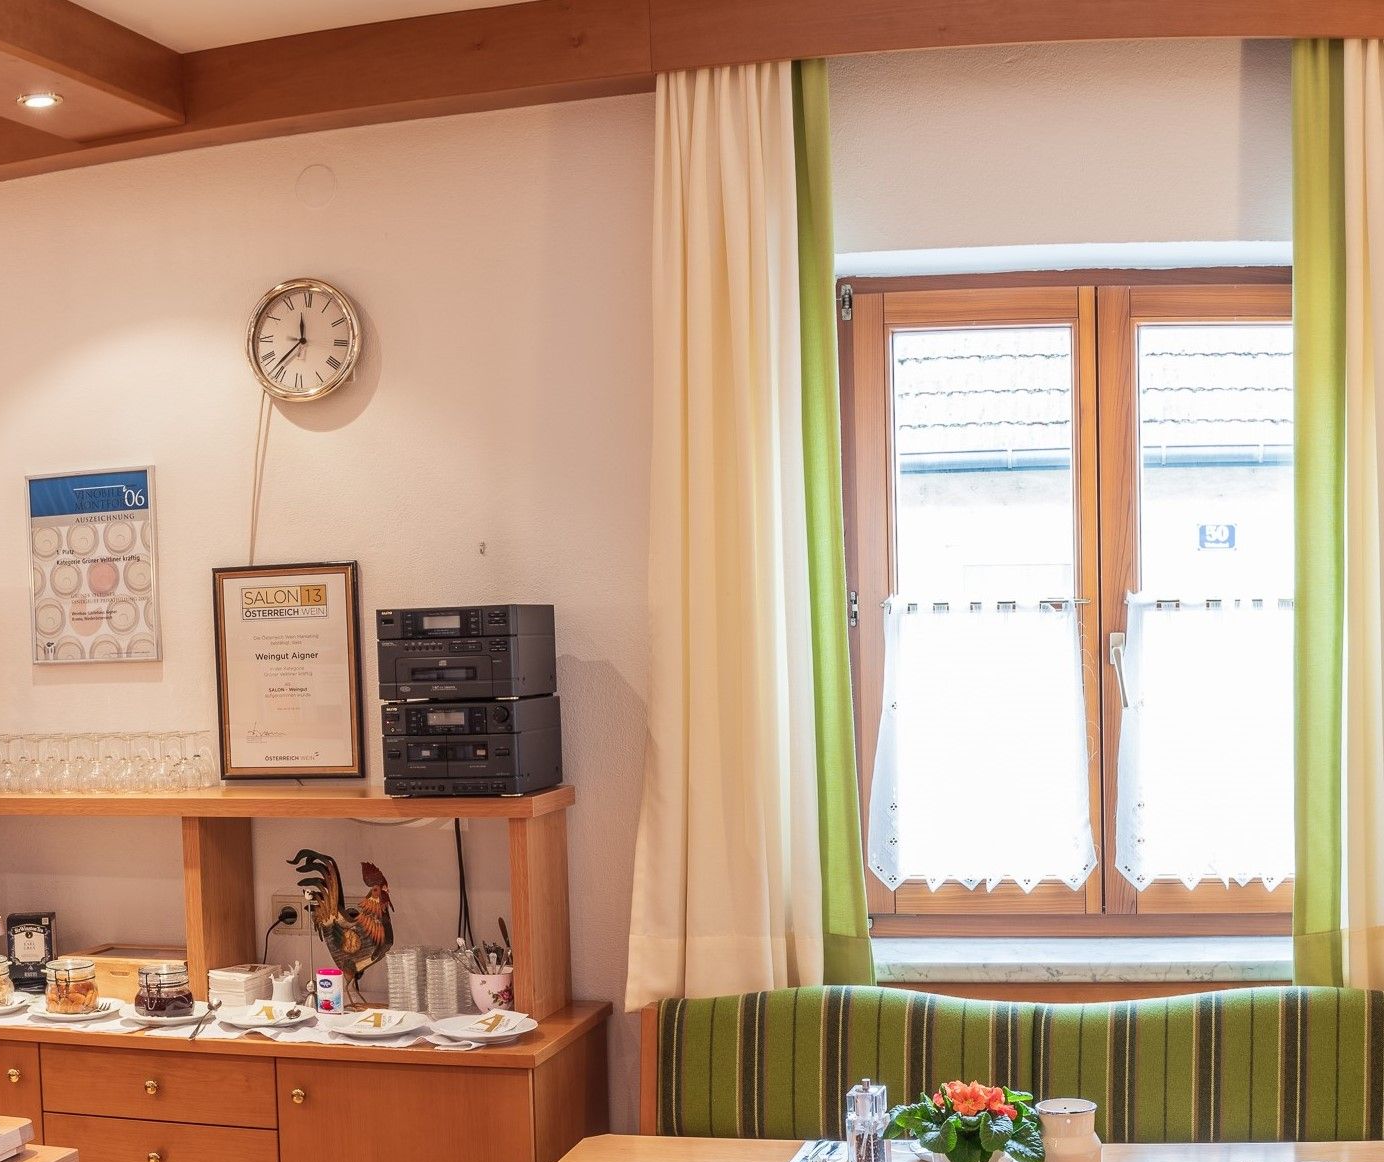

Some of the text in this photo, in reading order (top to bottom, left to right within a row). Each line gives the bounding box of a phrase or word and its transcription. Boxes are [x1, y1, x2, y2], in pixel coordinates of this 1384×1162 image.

[73, 499, 126, 512] MONTFO
[75, 513, 136, 524] AUSZEICHNUNG
[56, 554, 141, 567] Kategorie Grüner Veltliner kräftig
[244, 588, 322, 606] SALON 13
[244, 607, 326, 619] ÖSTERREICH WEIN
[255, 651, 319, 662] Weingut Aigner
